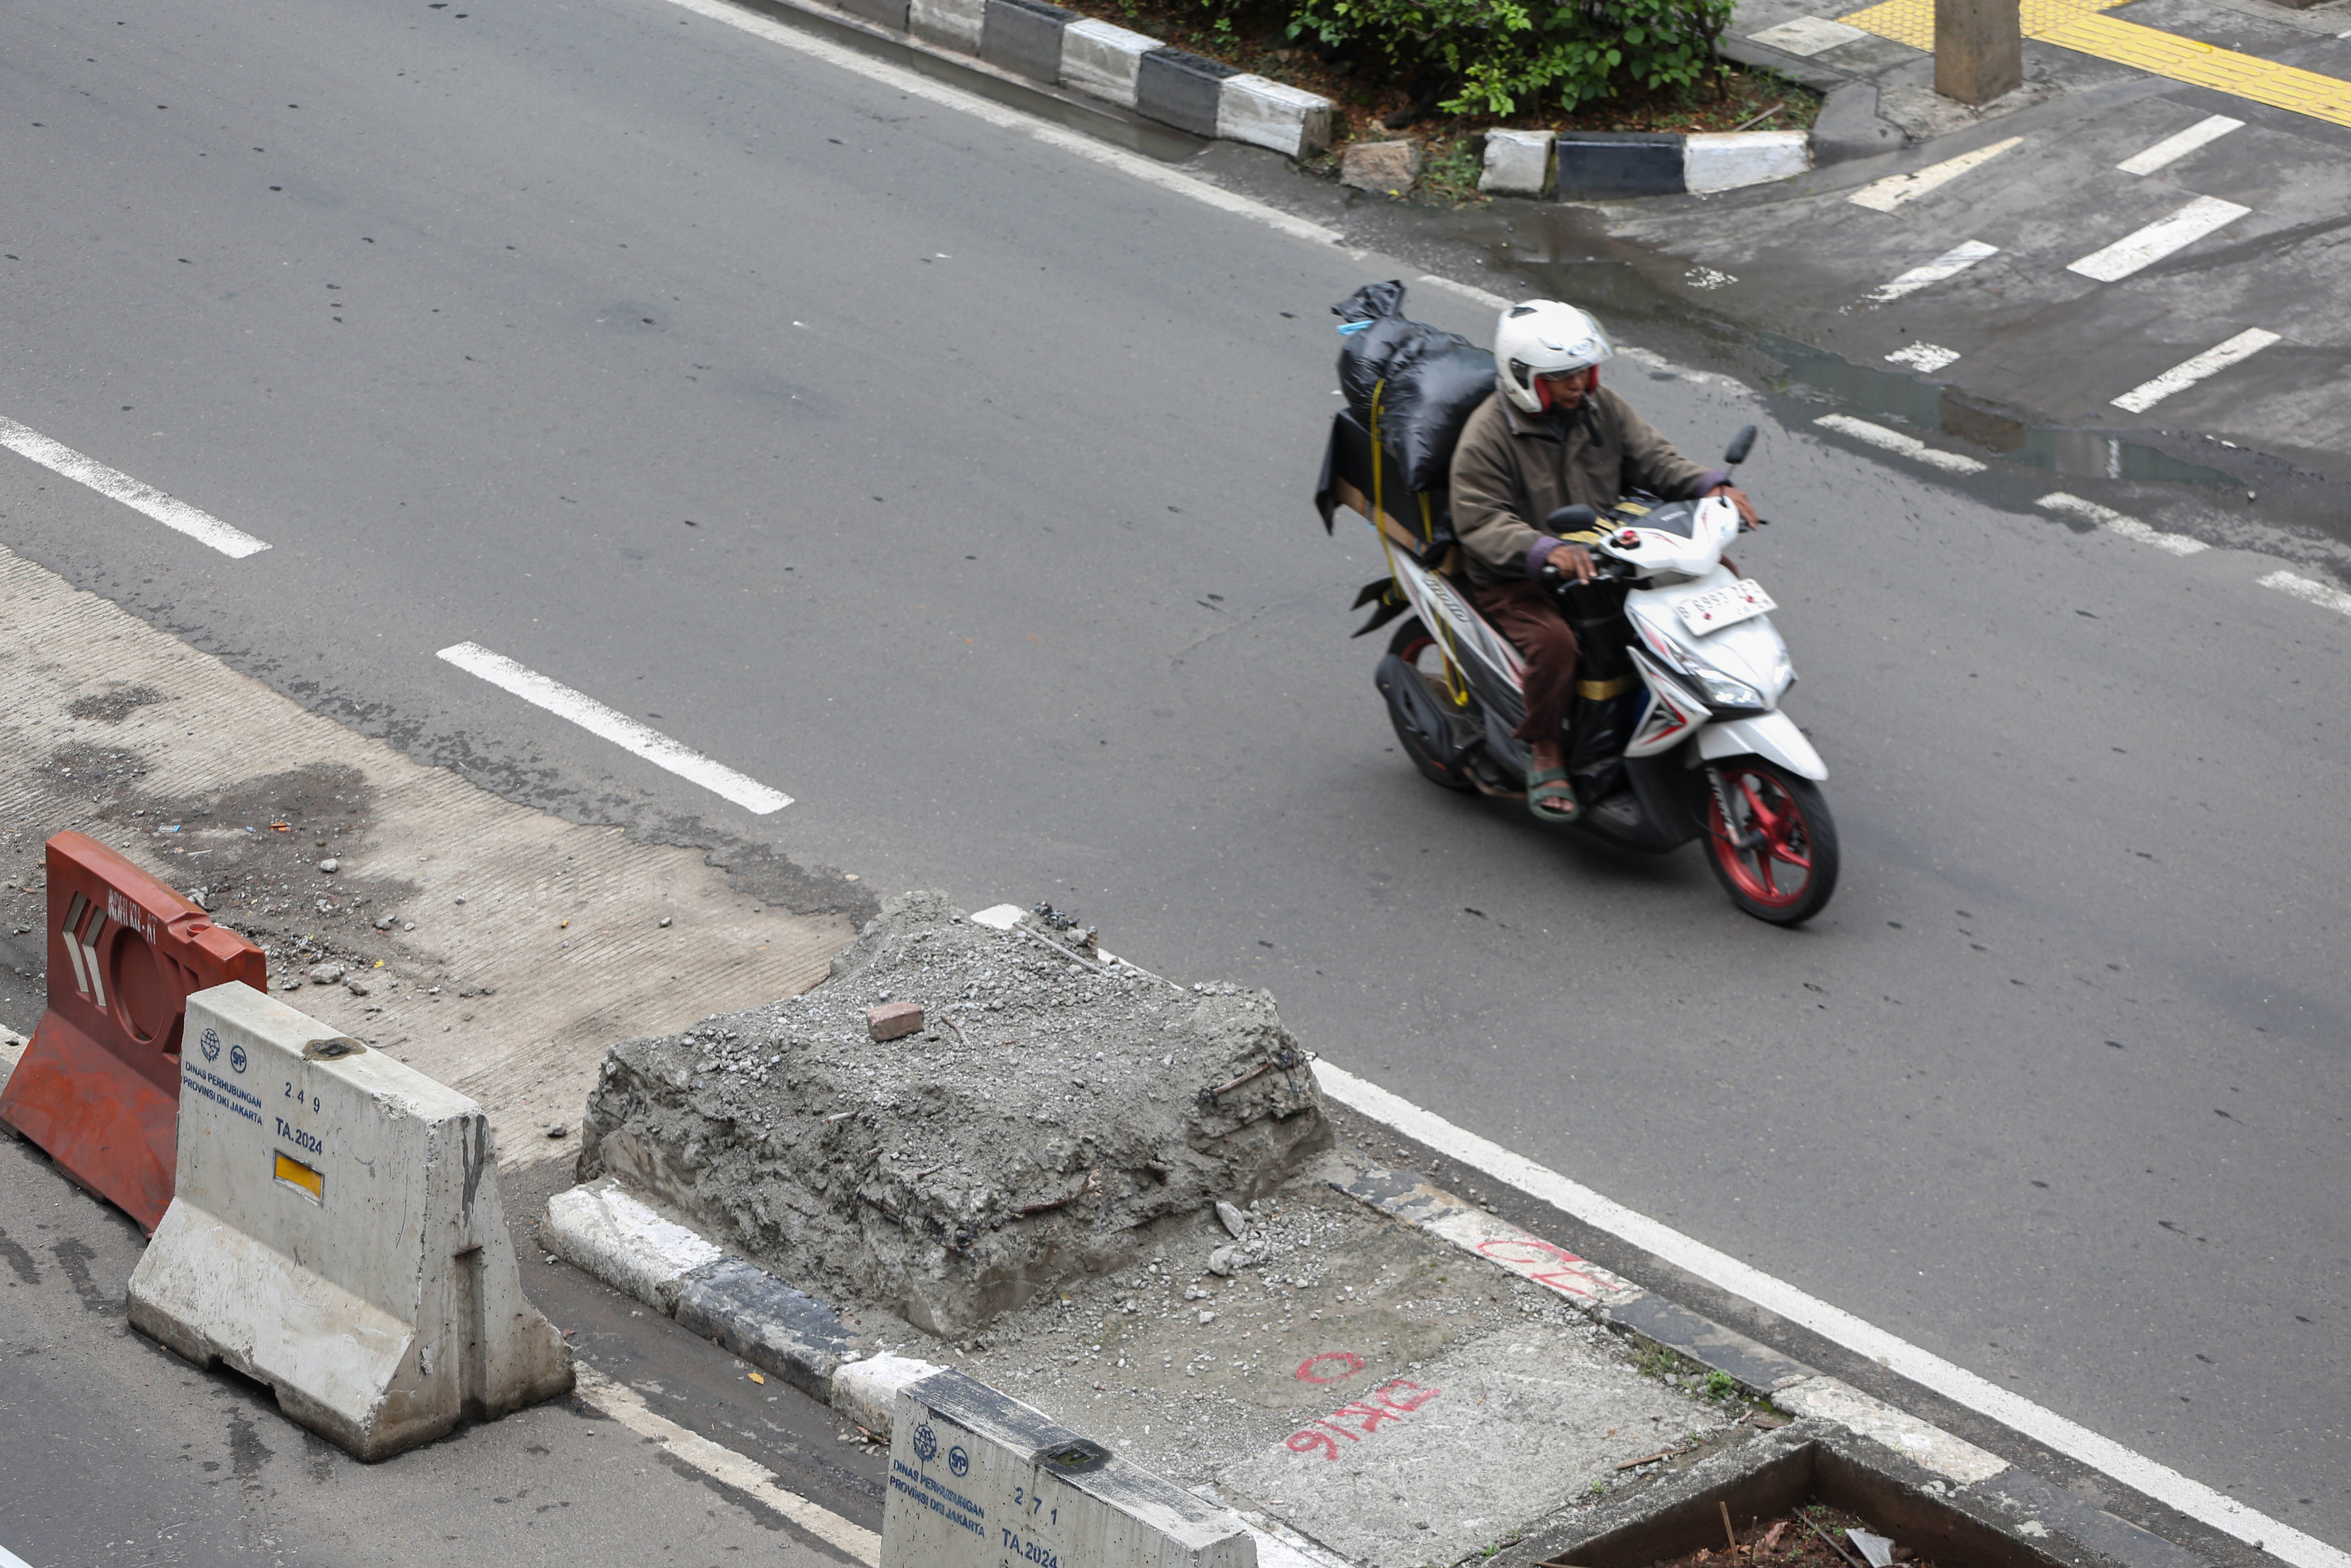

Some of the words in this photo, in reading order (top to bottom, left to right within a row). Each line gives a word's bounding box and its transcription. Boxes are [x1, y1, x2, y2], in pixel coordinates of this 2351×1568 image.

[183, 1076, 216, 1101] PROVINSI
[217, 1094, 229, 1108] DKI
[230, 1101, 263, 1126] JAKARTA
[185, 1061, 207, 1080] DINAS
[208, 1073, 262, 1109] PERHUBUNGAN
[276, 1116, 323, 1156] TA.2024
[889, 1475, 929, 1506] PROVINSI
[930, 1498, 945, 1515] DKI
[945, 1508, 985, 1538] JAKARTA
[894, 1459, 919, 1482] DINAS
[920, 1474, 985, 1519] PERHUBUNGAN
[1002, 1527, 1058, 1568] TA.2024
